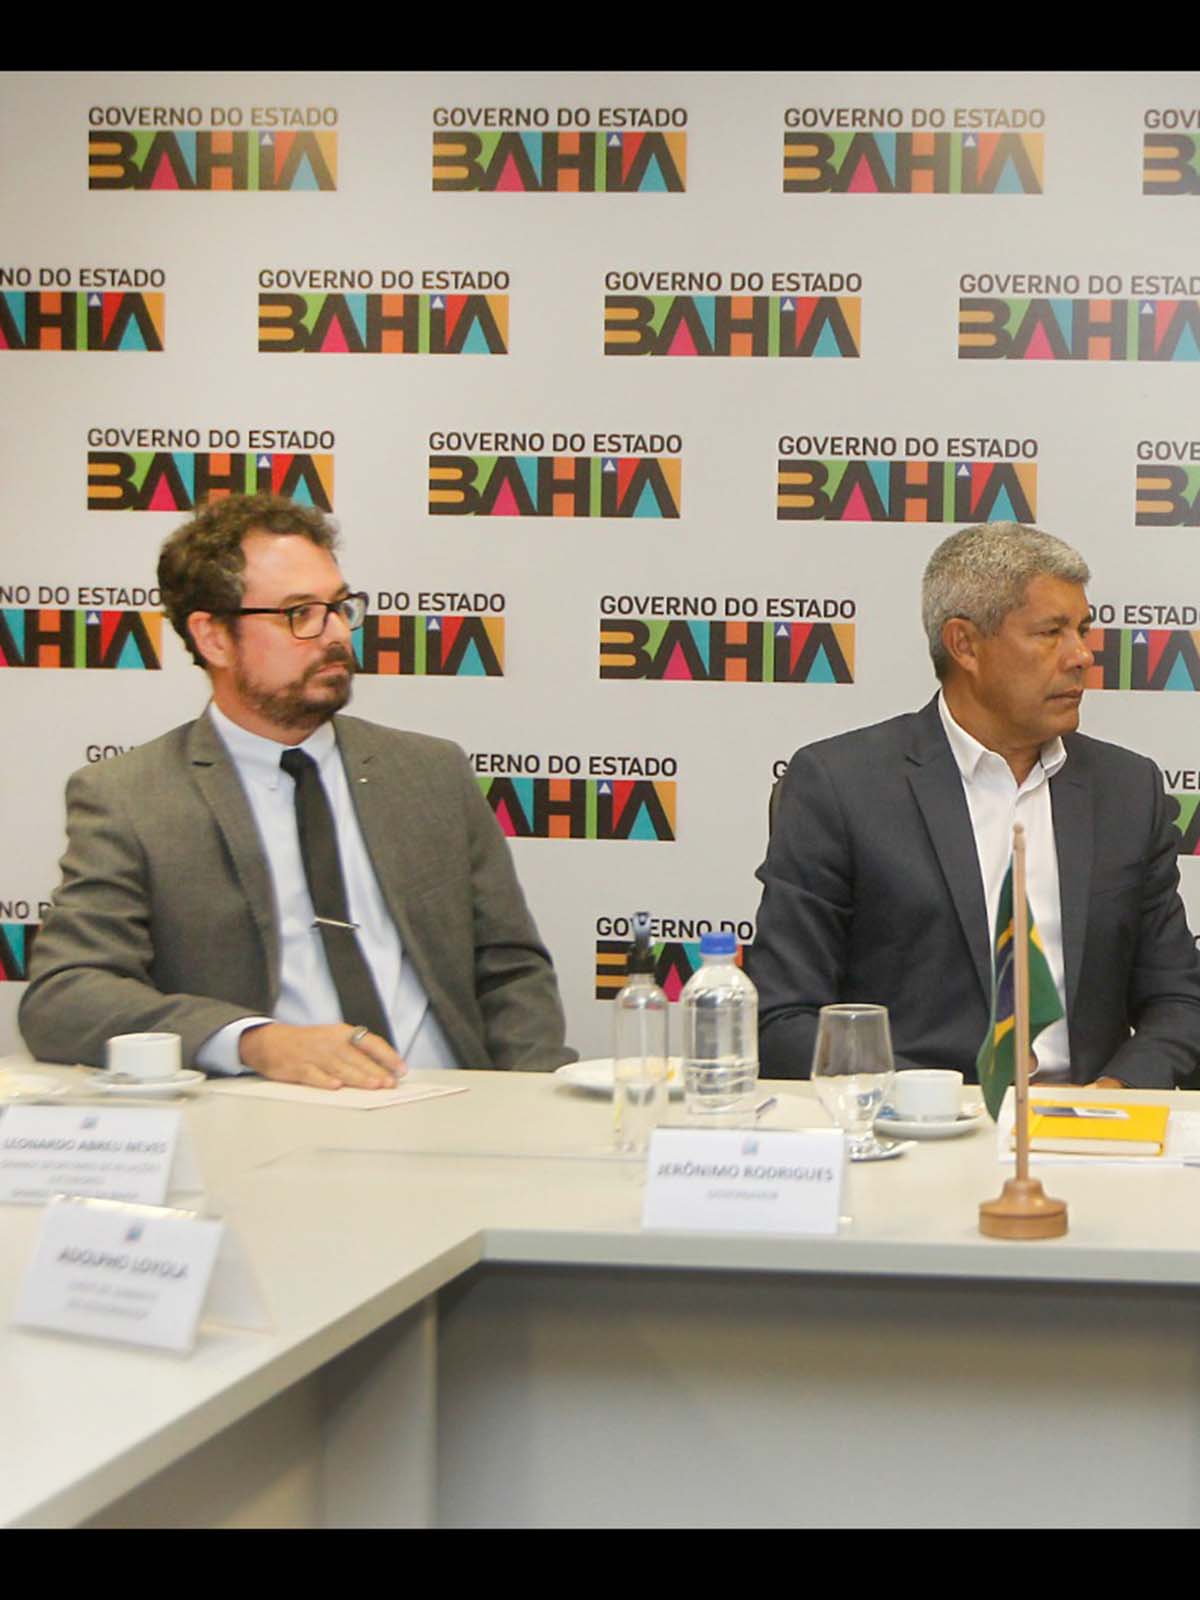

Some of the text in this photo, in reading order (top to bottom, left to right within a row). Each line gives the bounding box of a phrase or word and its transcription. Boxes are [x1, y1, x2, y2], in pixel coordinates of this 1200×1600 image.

[88, 106, 337, 126] GOVERNO DO ESTADO
[433, 108, 688, 127] GOVERNO DO ESTADO
[784, 108, 1044, 128] GOVERNO DO ESTADO
[88, 131, 336, 192] BAHIA
[432, 131, 687, 193] BAHIA
[784, 132, 1042, 194] BAHIA
[39, 268, 71, 287] DO
[79, 268, 165, 287] ESTADO
[259, 269, 510, 290] GOVERNO DO ESTADO
[605, 272, 862, 292] GOVERNO DO ESTADO
[960, 274, 1080, 294] GOVERNO
[1088, 275, 1122, 294] DO
[258, 293, 509, 355] BAHIA
[604, 296, 861, 358] BAHIA
[87, 428, 335, 449] GOVERNO DO ESTADO
[429, 432, 682, 453] GOVERNO DO ESTADO
[778, 436, 1038, 458] GOVERNO DO ESTADO
[87, 452, 334, 513] BAHIA
[429, 456, 681, 518] BAHIA
[778, 461, 1037, 523] BAHIA
[39, 586, 70, 605] DO
[78, 587, 161, 607] ESTADO
[378, 592, 505, 612] DO ESTADO
[600, 596, 856, 619] GOVERNO DO ESTADO
[600, 621, 855, 683] BAHIA
[470, 753, 677, 776] ERNO DO ESTADO
[487, 777, 677, 842] AHIA
[597, 917, 711, 938] GOERNO
[743, 1164, 833, 1182] RODRIGUES
